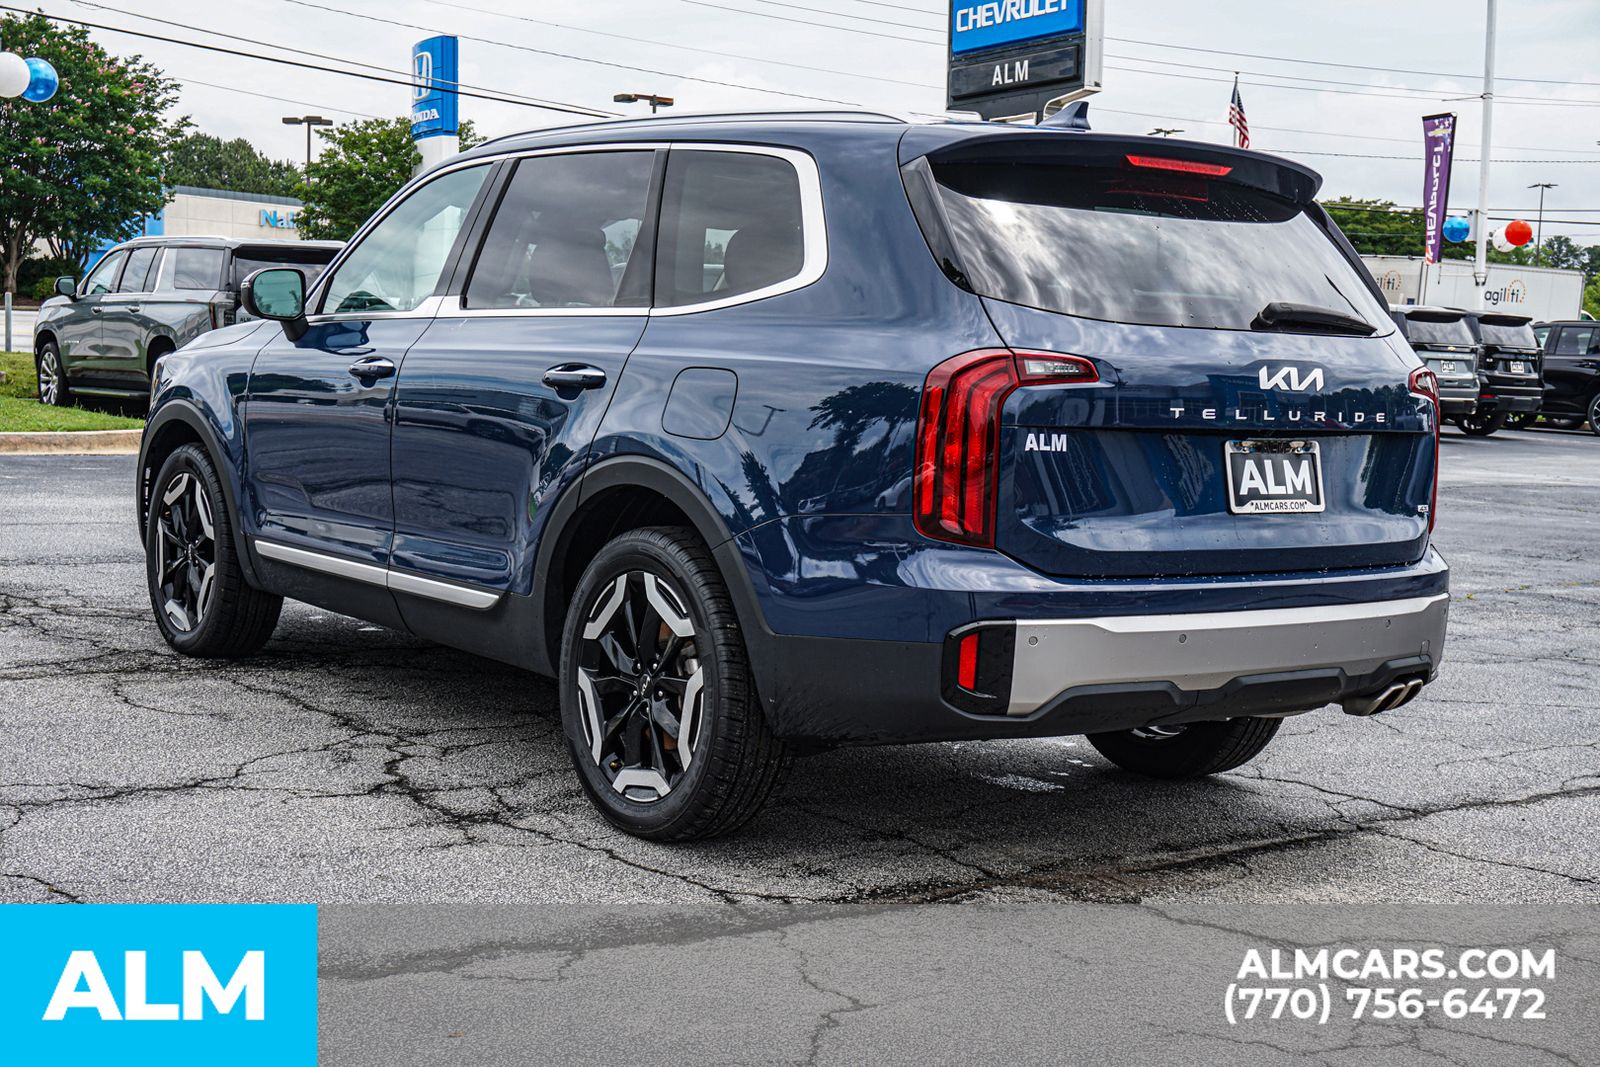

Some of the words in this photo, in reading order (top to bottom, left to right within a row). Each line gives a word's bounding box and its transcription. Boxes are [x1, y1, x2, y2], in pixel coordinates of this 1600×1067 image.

[992, 60, 1029, 86] ALM
[1484, 287, 1520, 305] agiliti
[1258, 365, 1324, 391] KIA
[1169, 407, 1386, 423] TELLURIDE
[1025, 433, 1067, 451] ALM
[1239, 459, 1313, 495] ALM
[1254, 501, 1306, 511] ALMCARS.COM
